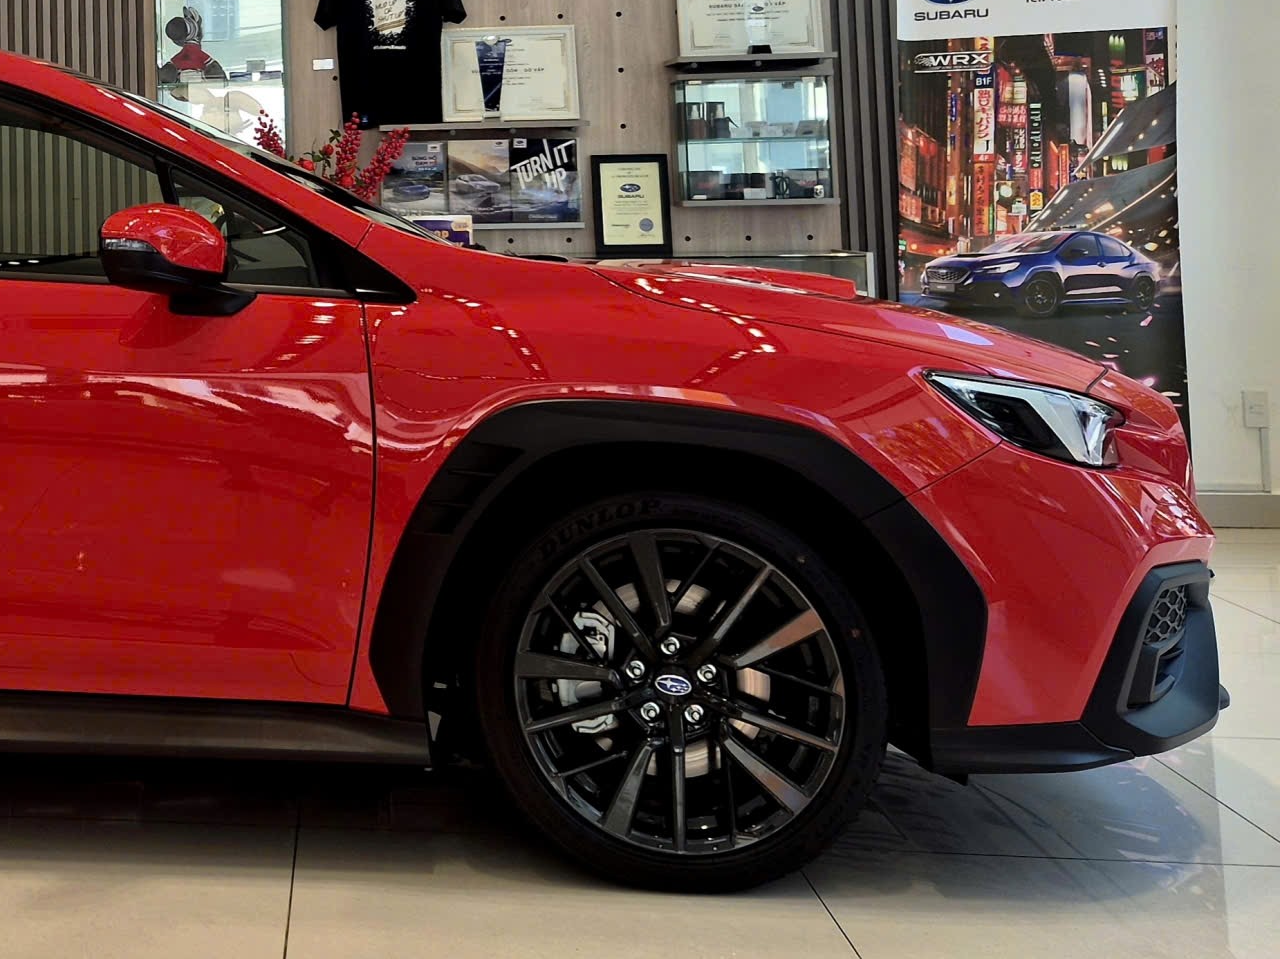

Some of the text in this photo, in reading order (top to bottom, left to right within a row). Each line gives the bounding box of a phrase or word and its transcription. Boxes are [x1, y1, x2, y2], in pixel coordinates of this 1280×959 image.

[914, 8, 989, 21] SUBARU
[930, 53, 988, 66] WRX
[975, 77, 992, 86] B1F
[510, 139, 576, 189] TURN IT
[544, 168, 567, 192] UP
[538, 498, 663, 557] DUNLOP
